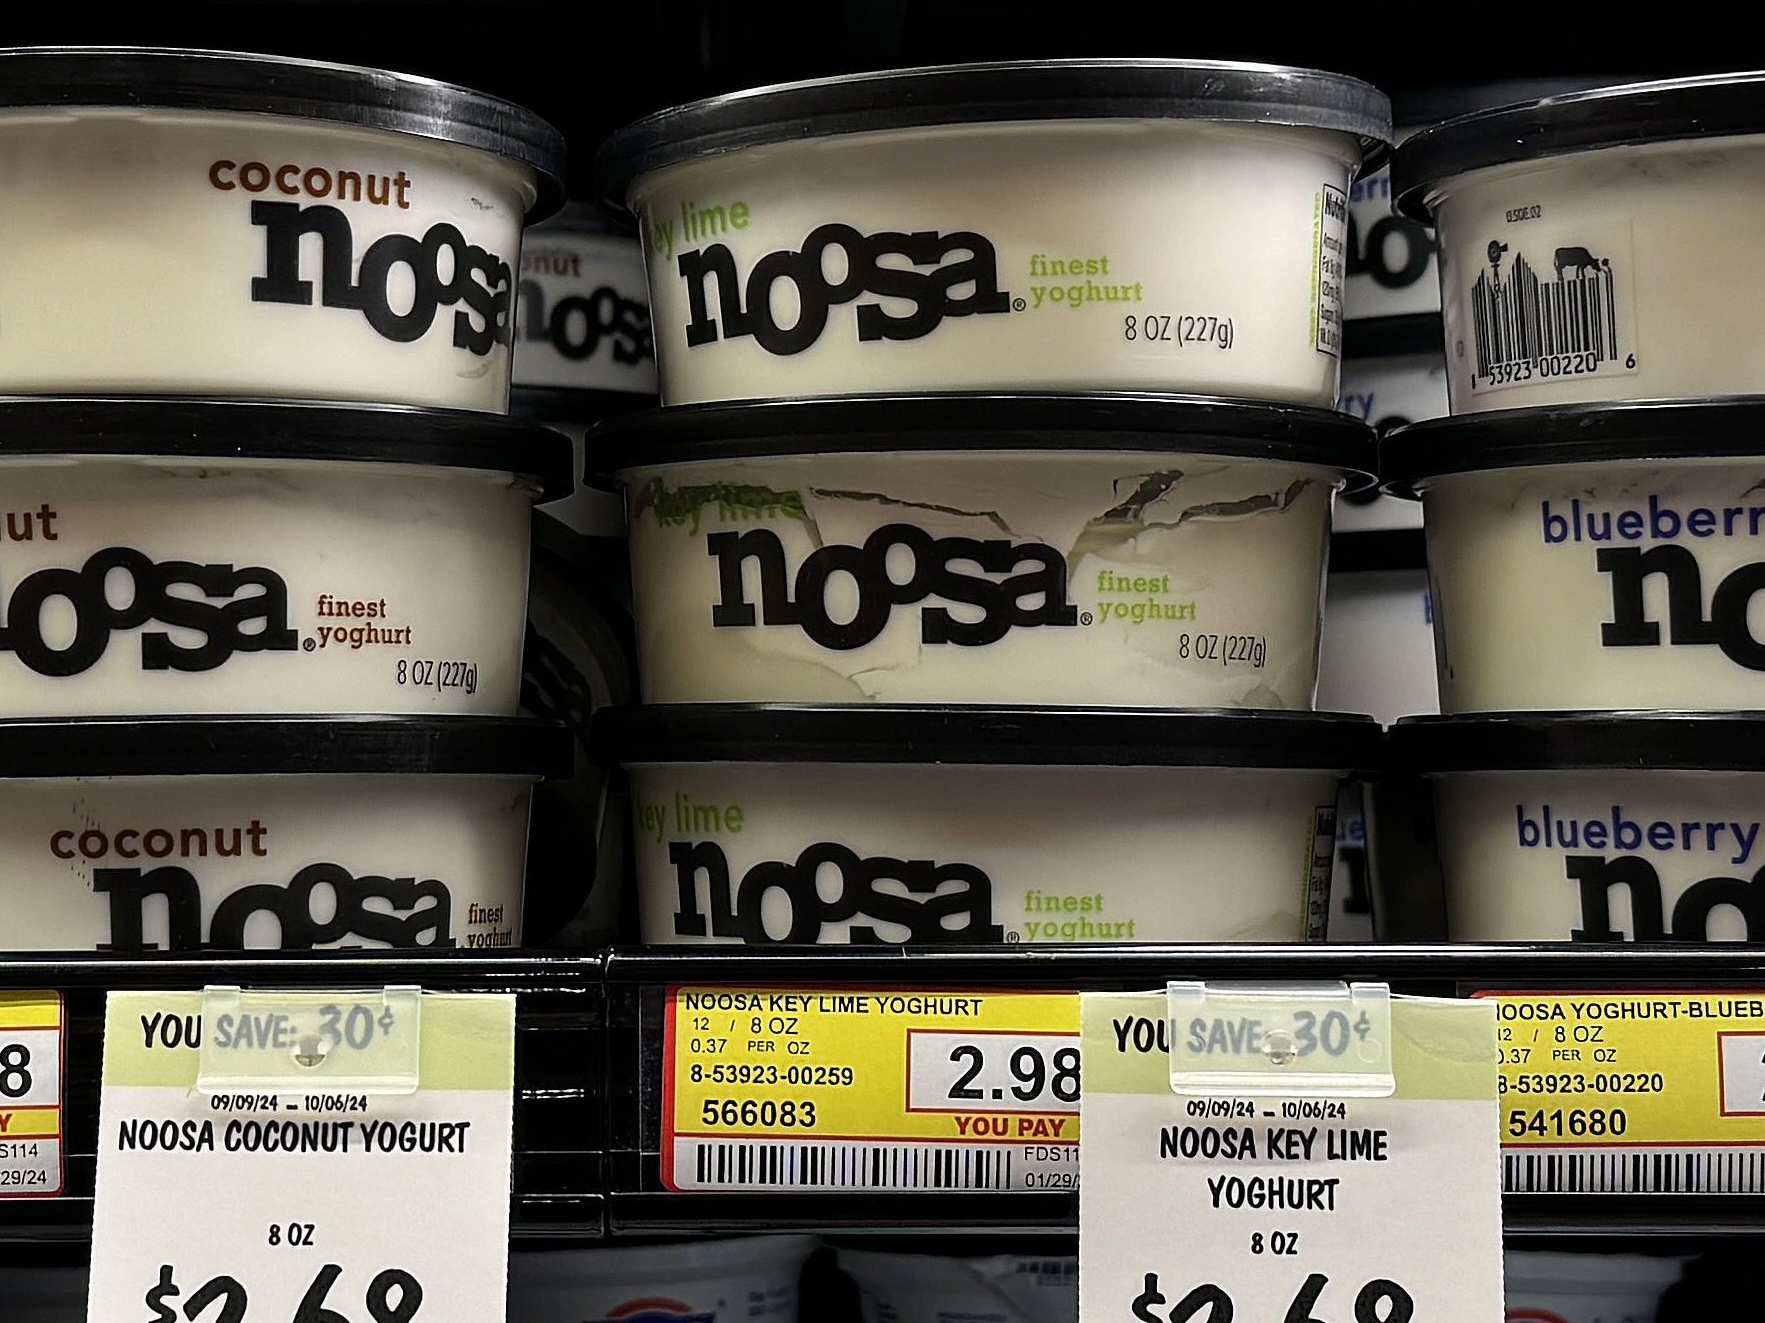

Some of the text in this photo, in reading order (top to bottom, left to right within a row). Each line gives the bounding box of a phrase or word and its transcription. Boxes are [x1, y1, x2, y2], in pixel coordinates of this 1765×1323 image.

[1030, 255, 1109, 277] finest
[677, 223, 1011, 355] noosa
[1031, 281, 1143, 309] yoghurt
[1125, 317, 1235, 350] 8 OZ (227g)
[317, 596, 386, 621] finest
[317, 622, 411, 648] yoghurt
[117, 1120, 471, 1154] NOOSA COCONUT YOGURT
[1160, 1129, 1387, 1161] NOOSA KEY LIME
[1208, 1177, 1339, 1211] YOGHURT
